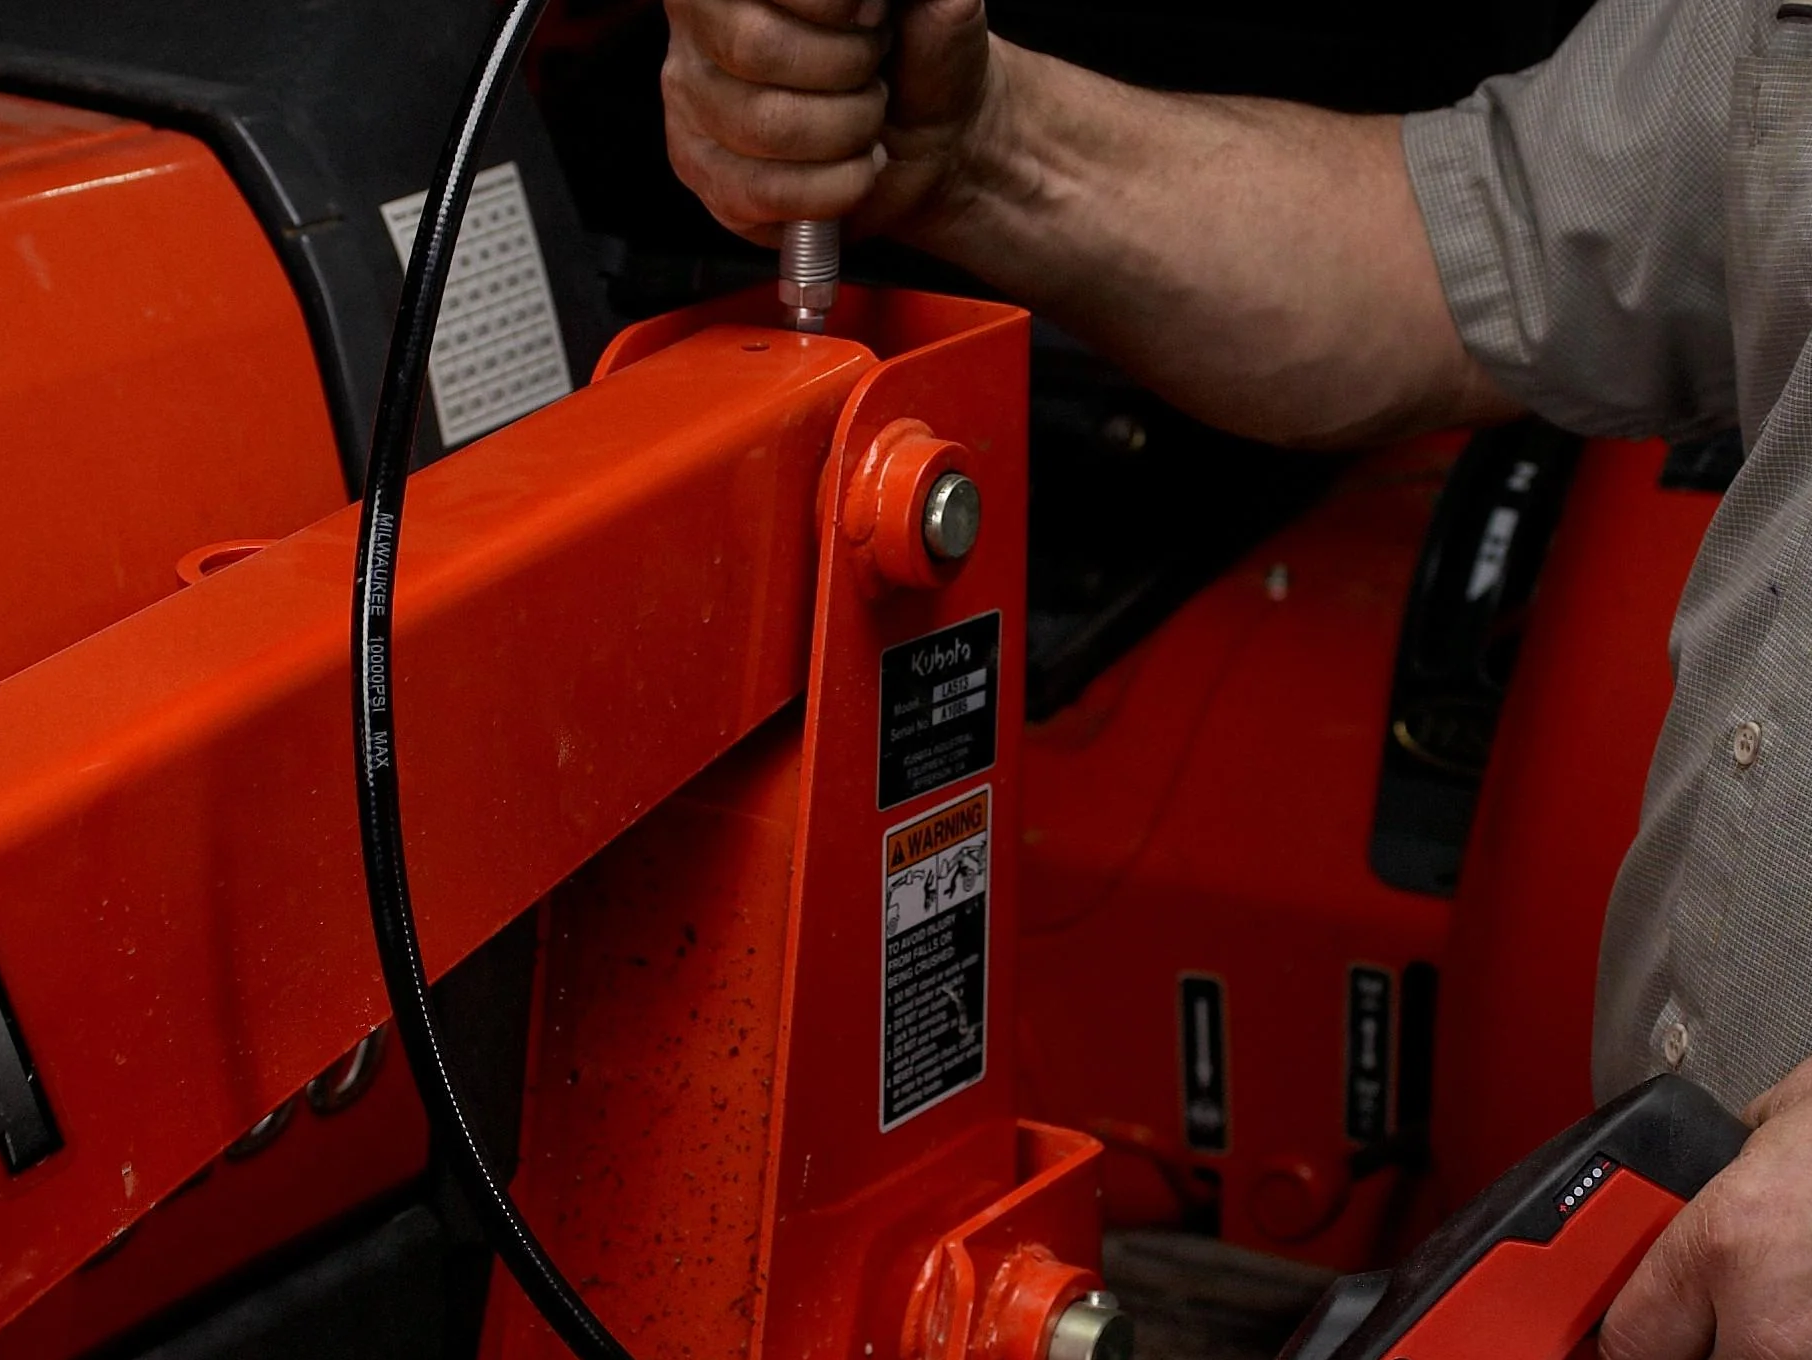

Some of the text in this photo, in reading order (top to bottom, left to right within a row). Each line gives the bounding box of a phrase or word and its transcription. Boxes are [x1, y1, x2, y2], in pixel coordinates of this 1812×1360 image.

[369, 511, 395, 770] MILWAUKEE 10000PSI MAX
[911, 638, 971, 676] Kubota
[907, 802, 982, 858] WARNING
